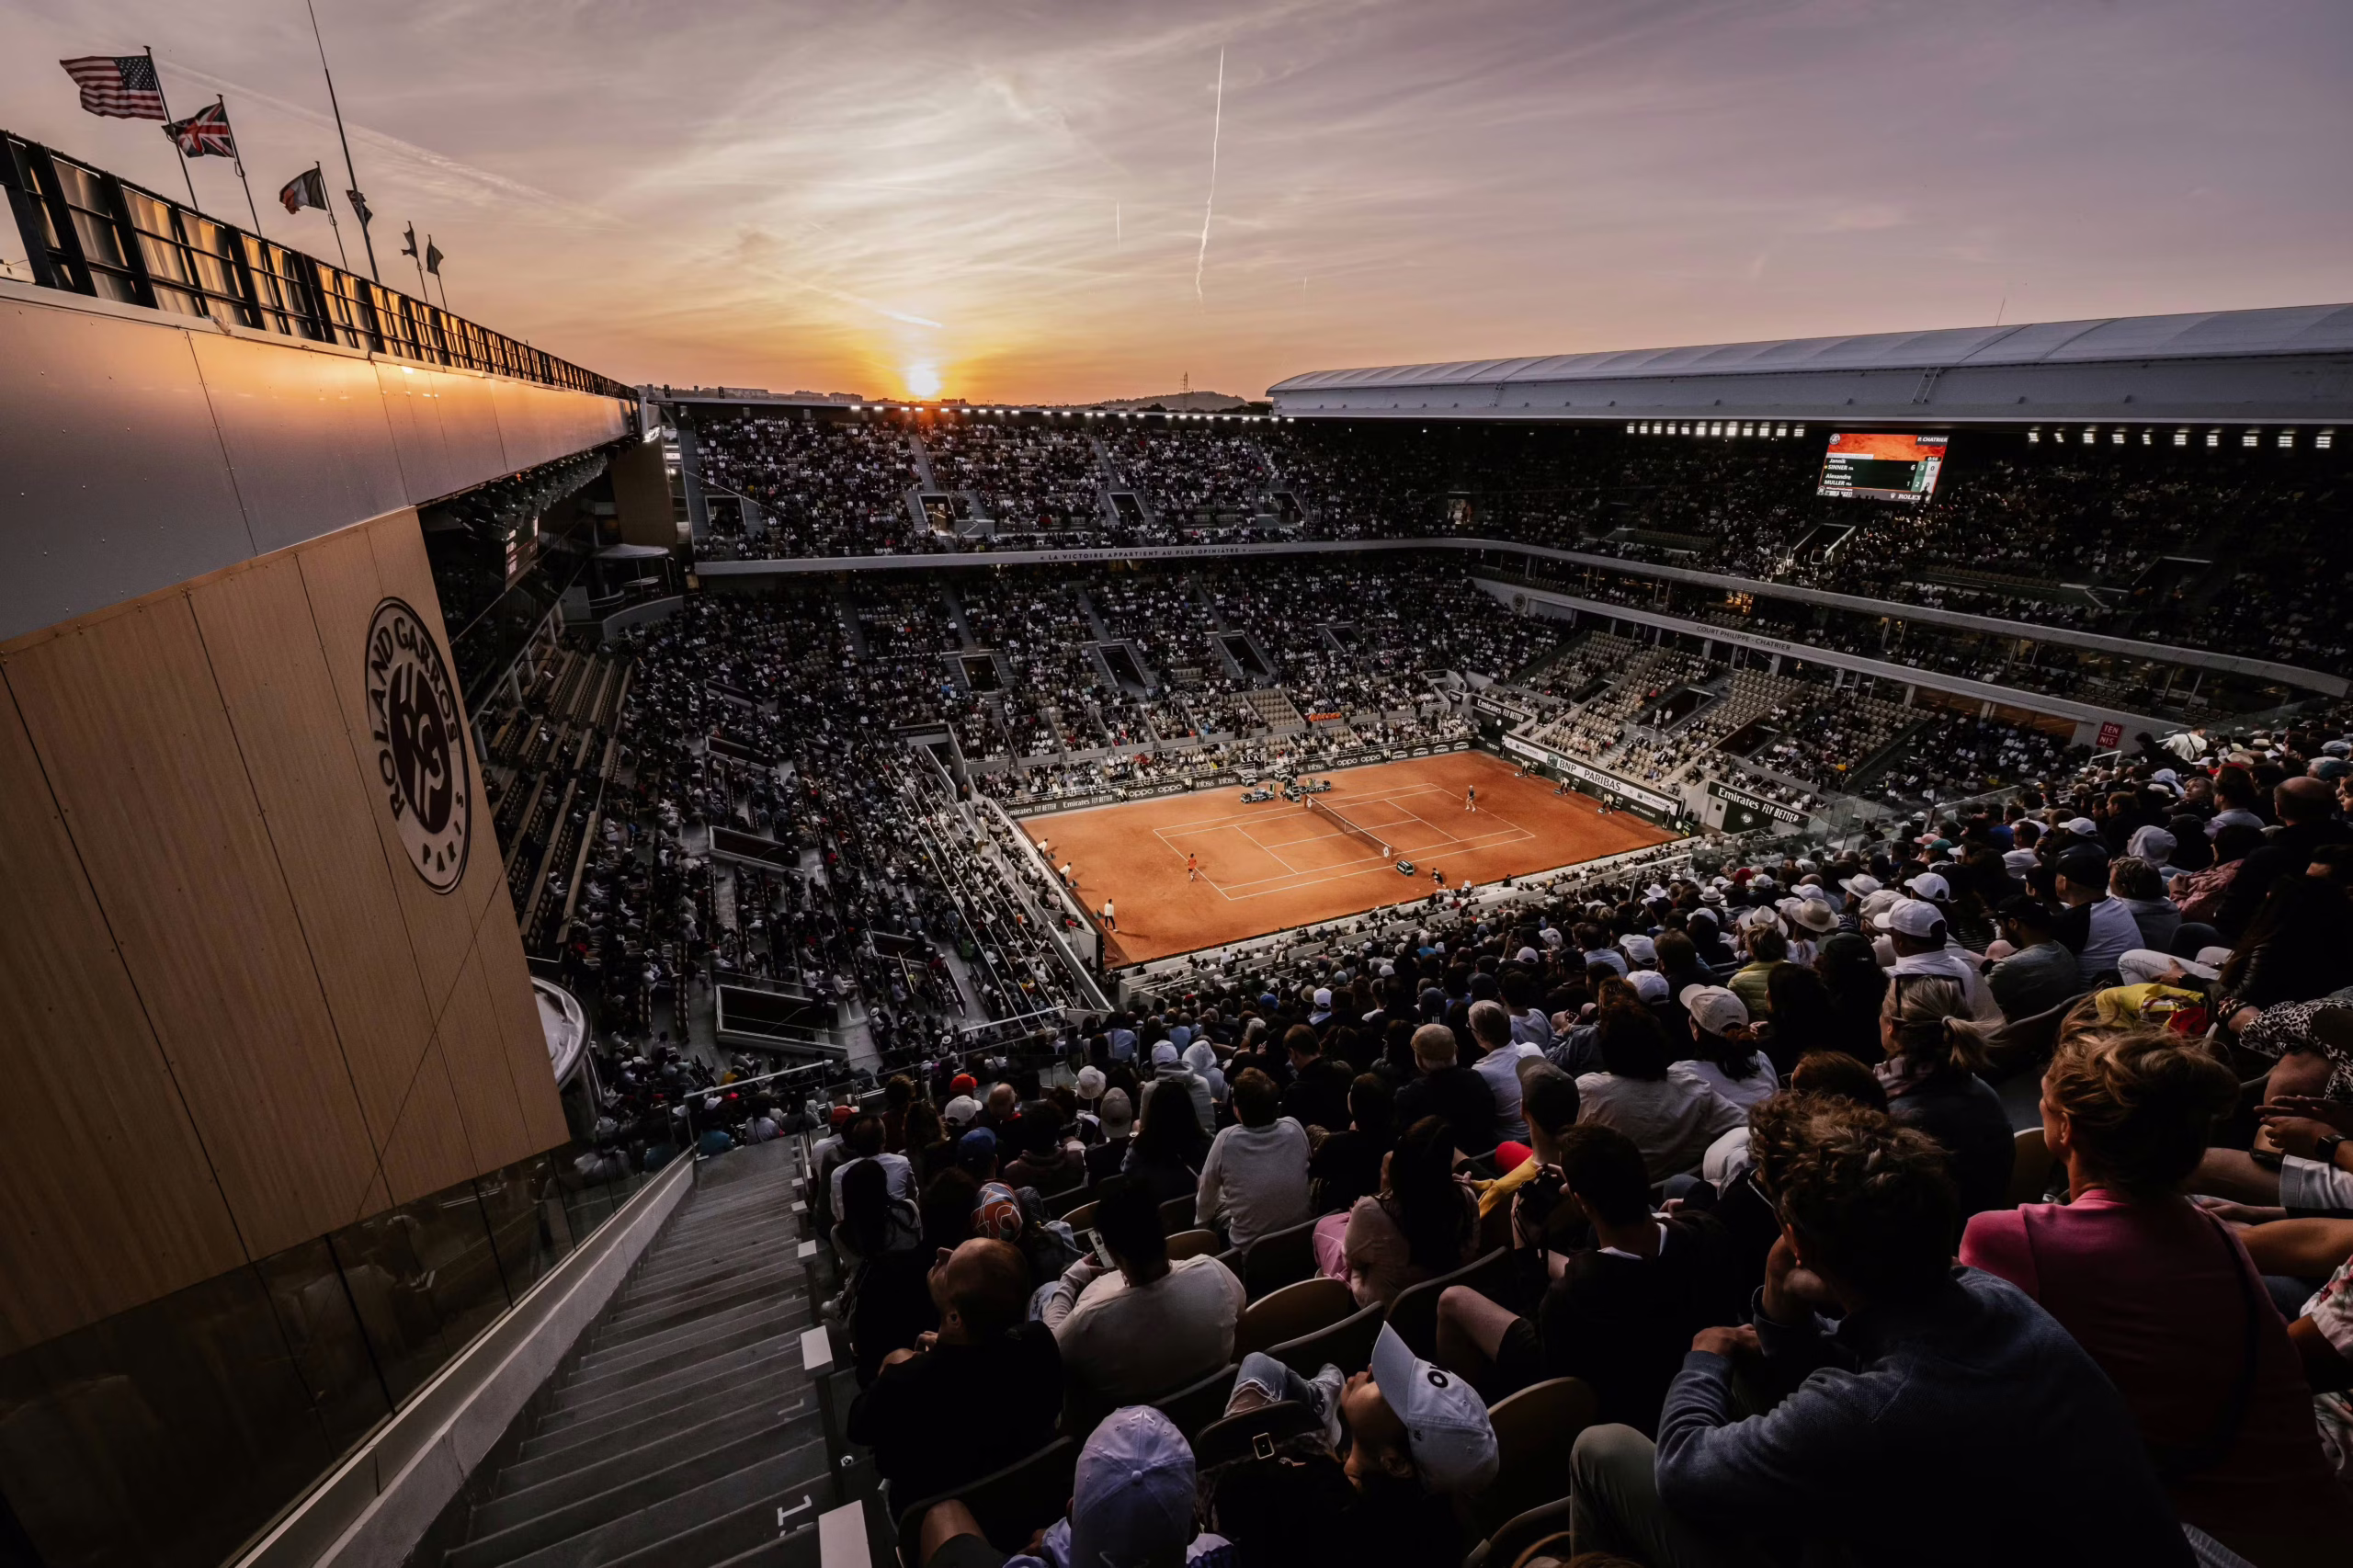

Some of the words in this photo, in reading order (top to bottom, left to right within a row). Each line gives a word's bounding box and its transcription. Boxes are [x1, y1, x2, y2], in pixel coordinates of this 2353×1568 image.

[1697, 626, 1719, 636] COURT
[1720, 631, 1750, 642] PHILIPPE
[1756, 638, 1791, 651] CHATRIER
[1477, 699, 1501, 714] Emirates
[1509, 710, 1524, 722] BETTER
[370, 625, 405, 821] ROLAND
[393, 616, 458, 744] GARROS
[2104, 724, 2120, 734] TEN
[2099, 735, 2114, 745] NIS
[1337, 758, 1358, 767] oppo
[1361, 755, 1381, 763] oppo
[1559, 759, 1576, 772] BNP
[1584, 769, 1620, 791] PARIBAS
[1129, 788, 1154, 798] oppo
[1158, 783, 1183, 794] oppo
[1042, 802, 1057, 812] BETTER
[1063, 799, 1090, 809] Emirates
[1099, 794, 1113, 802] BETTER
[1718, 787, 1759, 810] Emirates
[1761, 803, 1774, 815] FLY
[1774, 808, 1799, 823] BETTER
[422, 791, 463, 872] PARIS
